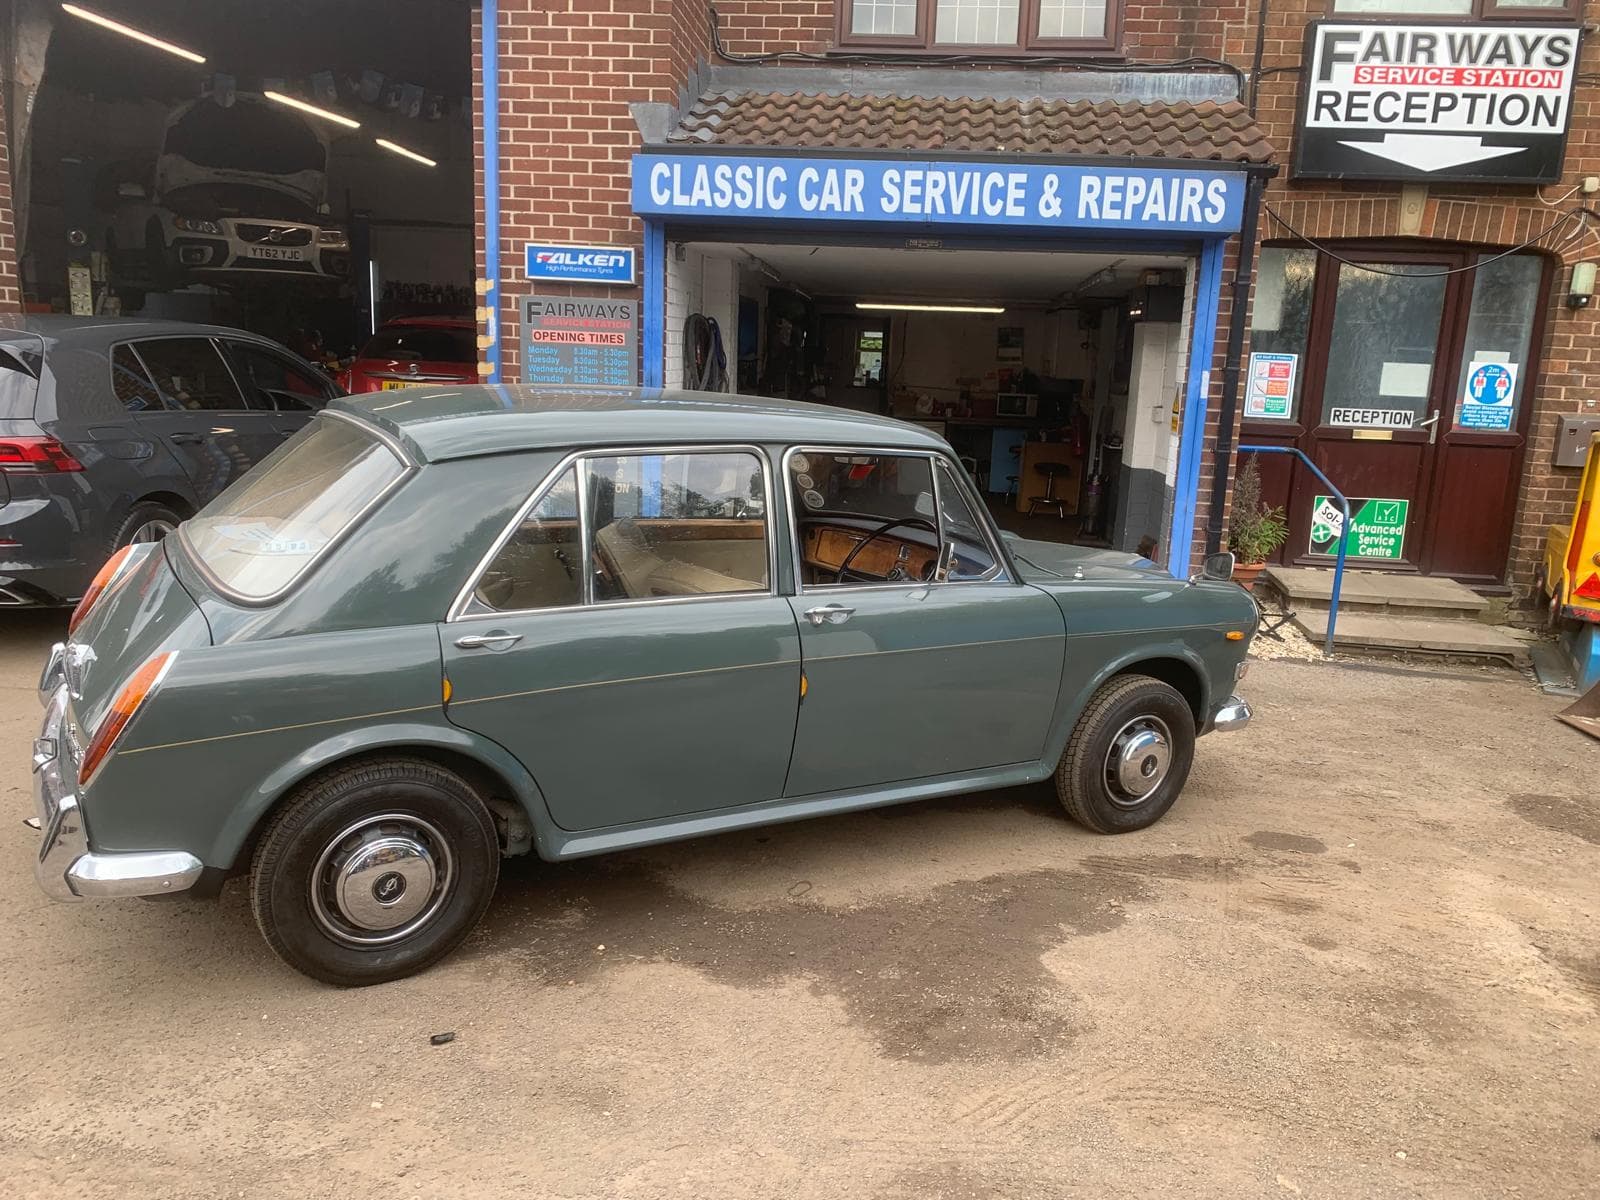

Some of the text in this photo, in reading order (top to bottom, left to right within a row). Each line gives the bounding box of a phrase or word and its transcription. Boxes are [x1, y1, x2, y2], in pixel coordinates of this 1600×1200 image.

[1317, 30, 1573, 83] FAIRWAYS
[1357, 67, 1562, 88] SERVICE STATION
[1313, 90, 1562, 128] RECEPTION
[650, 162, 1228, 224] CLASSIC CAR SERVICE & REPAIRS
[252, 247, 300, 260] YT62 YJC
[536, 252, 626, 268] FALKEN
[526, 302, 631, 324] FAIRWAYS
[533, 331, 624, 344] OPENING TIMES
[528, 346, 559, 355] Monday
[528, 355, 560, 364] Tuesday
[528, 364, 573, 375] Wednesday
[528, 374, 564, 384] Thursday
[1332, 409, 1413, 425] RECEPTION
[1350, 523, 1403, 535] Advanced
[1358, 534, 1396, 546] Service
[1358, 545, 1393, 557] Centre
